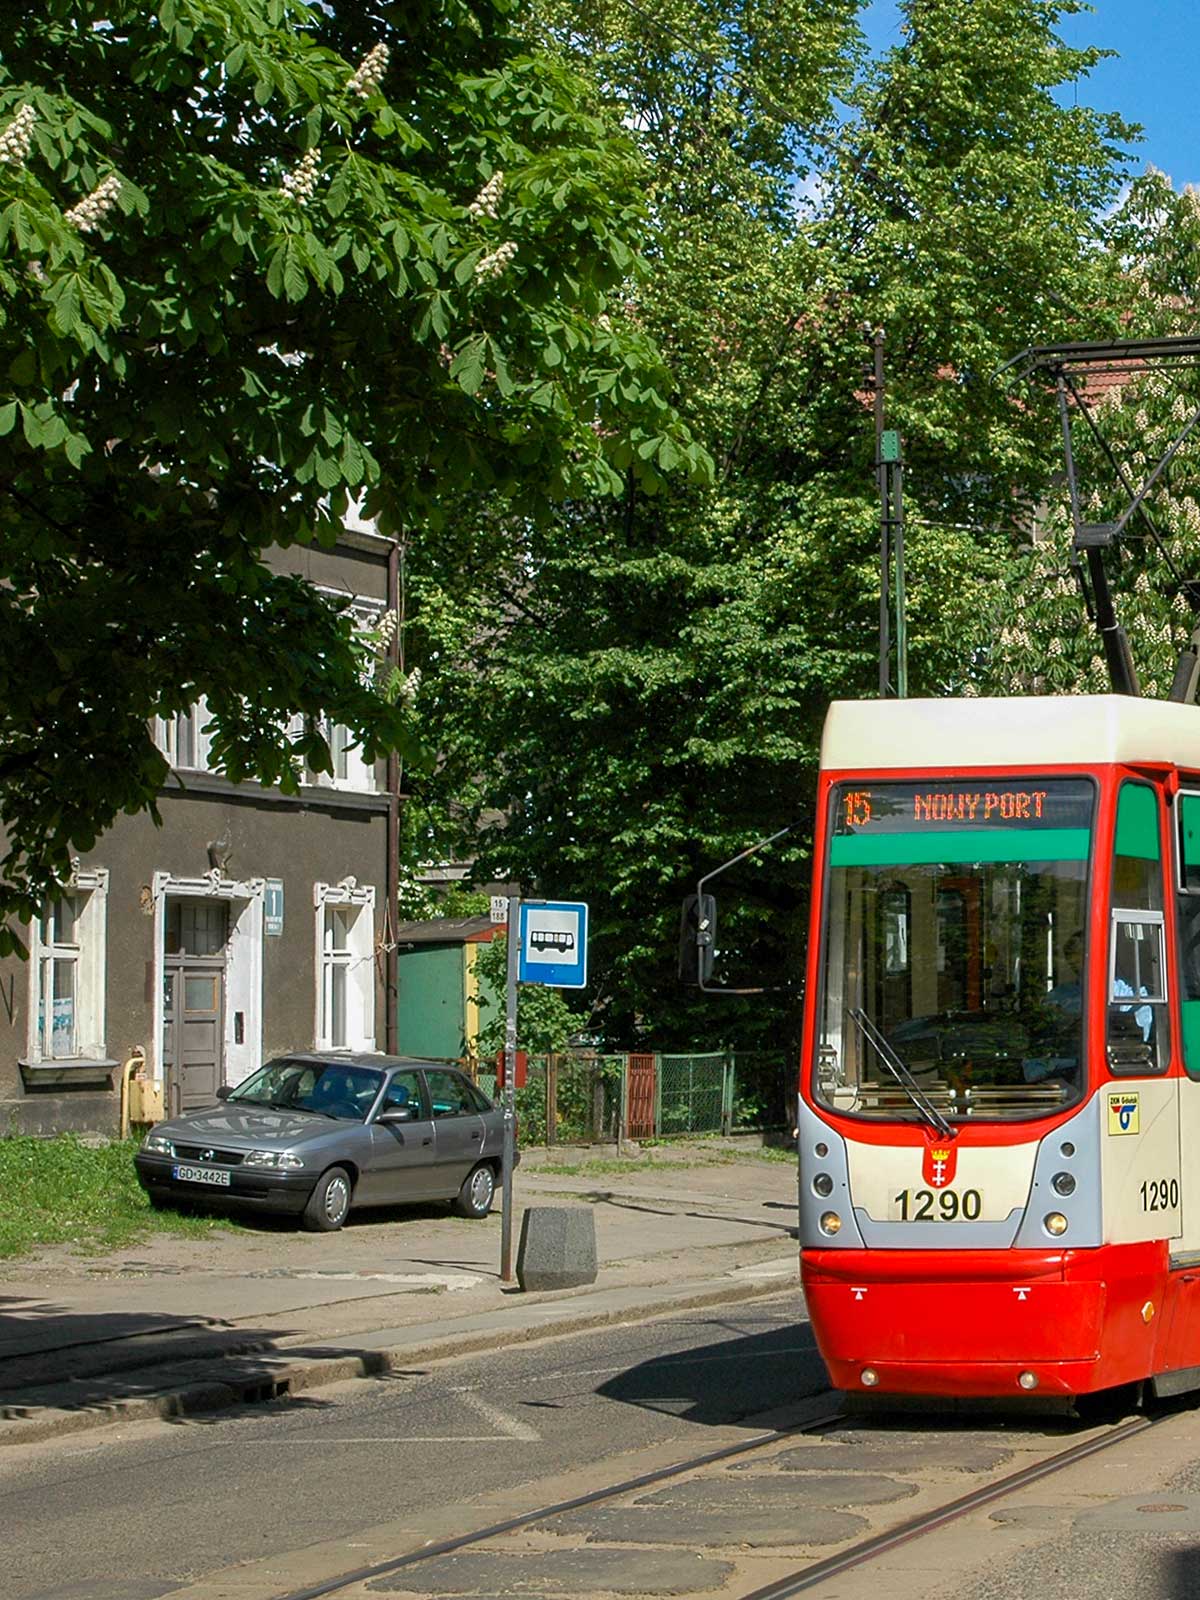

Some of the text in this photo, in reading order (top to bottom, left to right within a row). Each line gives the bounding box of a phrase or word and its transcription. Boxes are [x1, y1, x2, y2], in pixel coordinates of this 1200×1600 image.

[843, 792, 871, 826] 15
[913, 791, 1047, 821] NOWY PORT
[179, 1167, 228, 1185] GD 3442E
[894, 1189, 982, 1222] 1290
[1140, 1179, 1179, 1212] 1290
